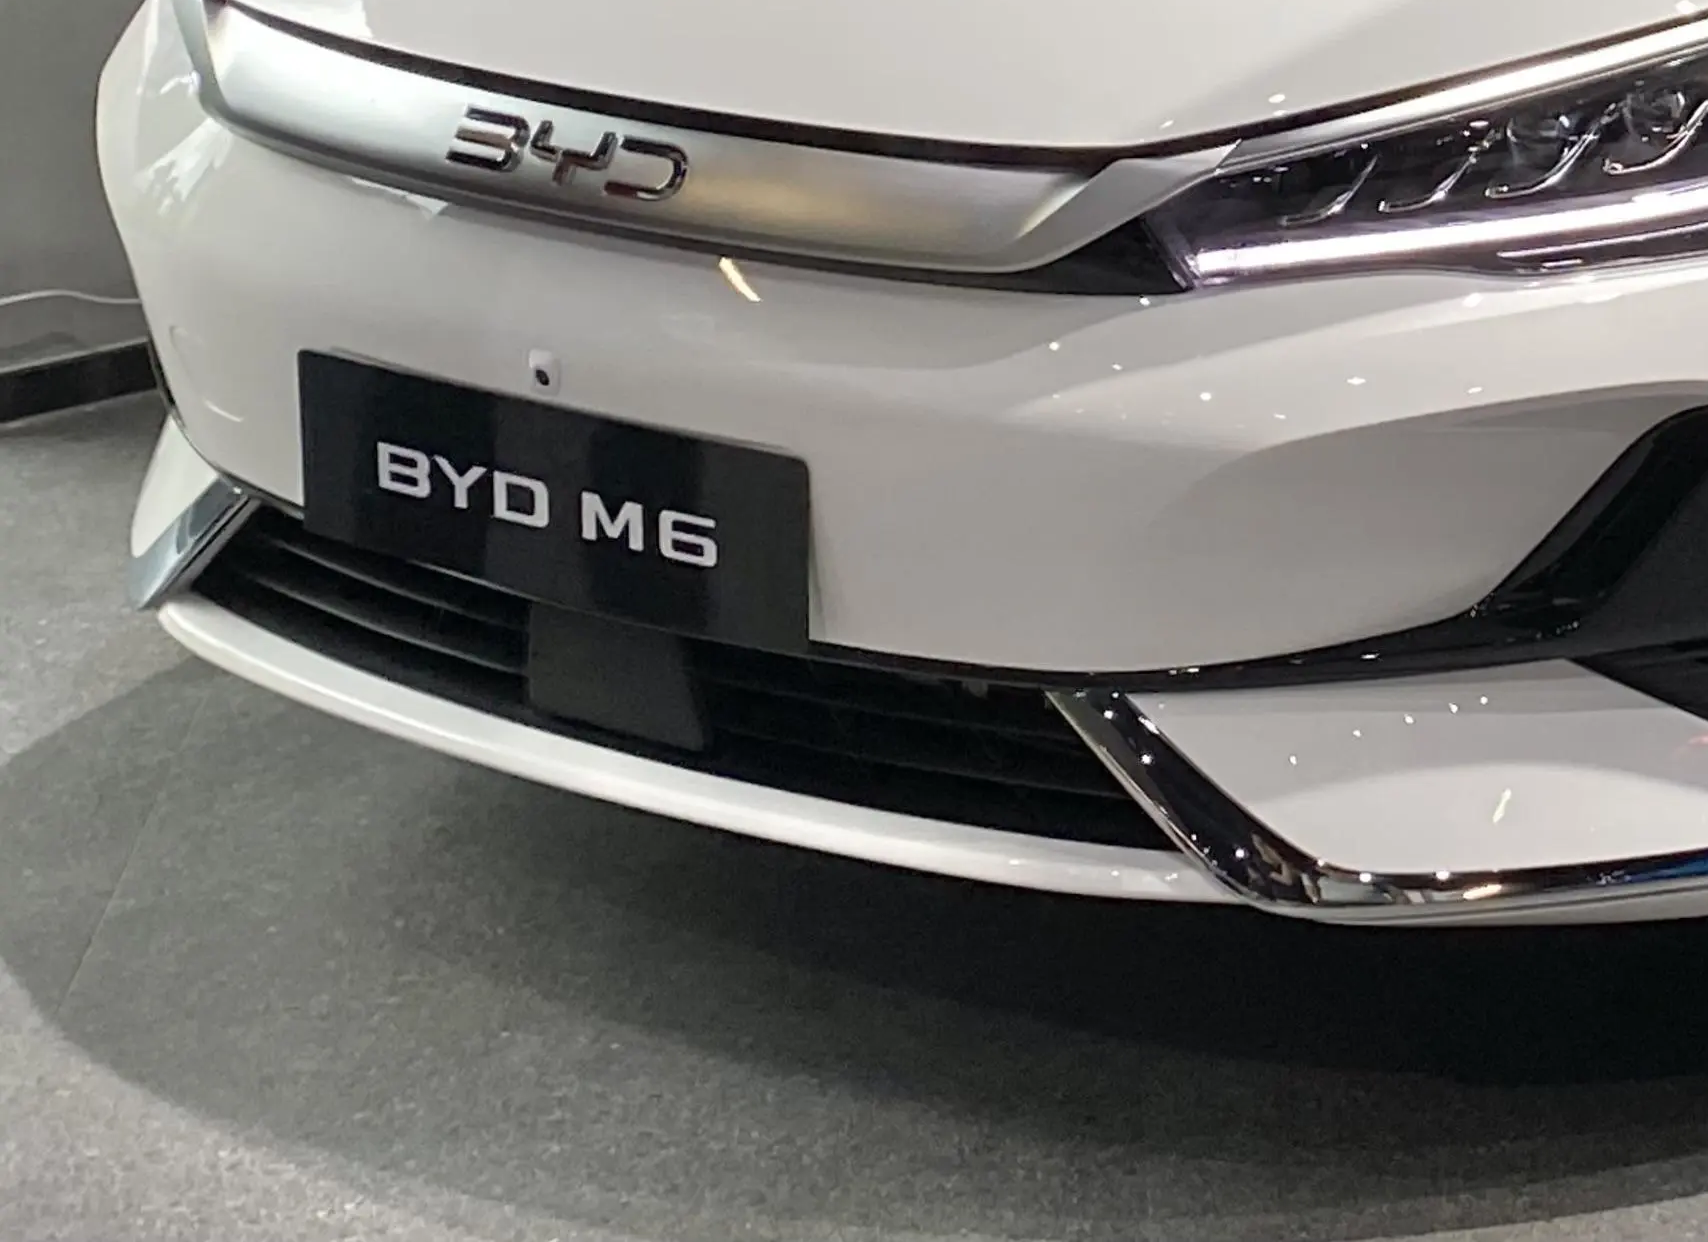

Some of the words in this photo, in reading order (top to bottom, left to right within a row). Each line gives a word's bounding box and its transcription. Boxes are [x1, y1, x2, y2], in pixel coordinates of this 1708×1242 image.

[445, 103, 690, 201] BYD
[376, 441, 549, 529] BYD
[581, 489, 719, 568] M6
